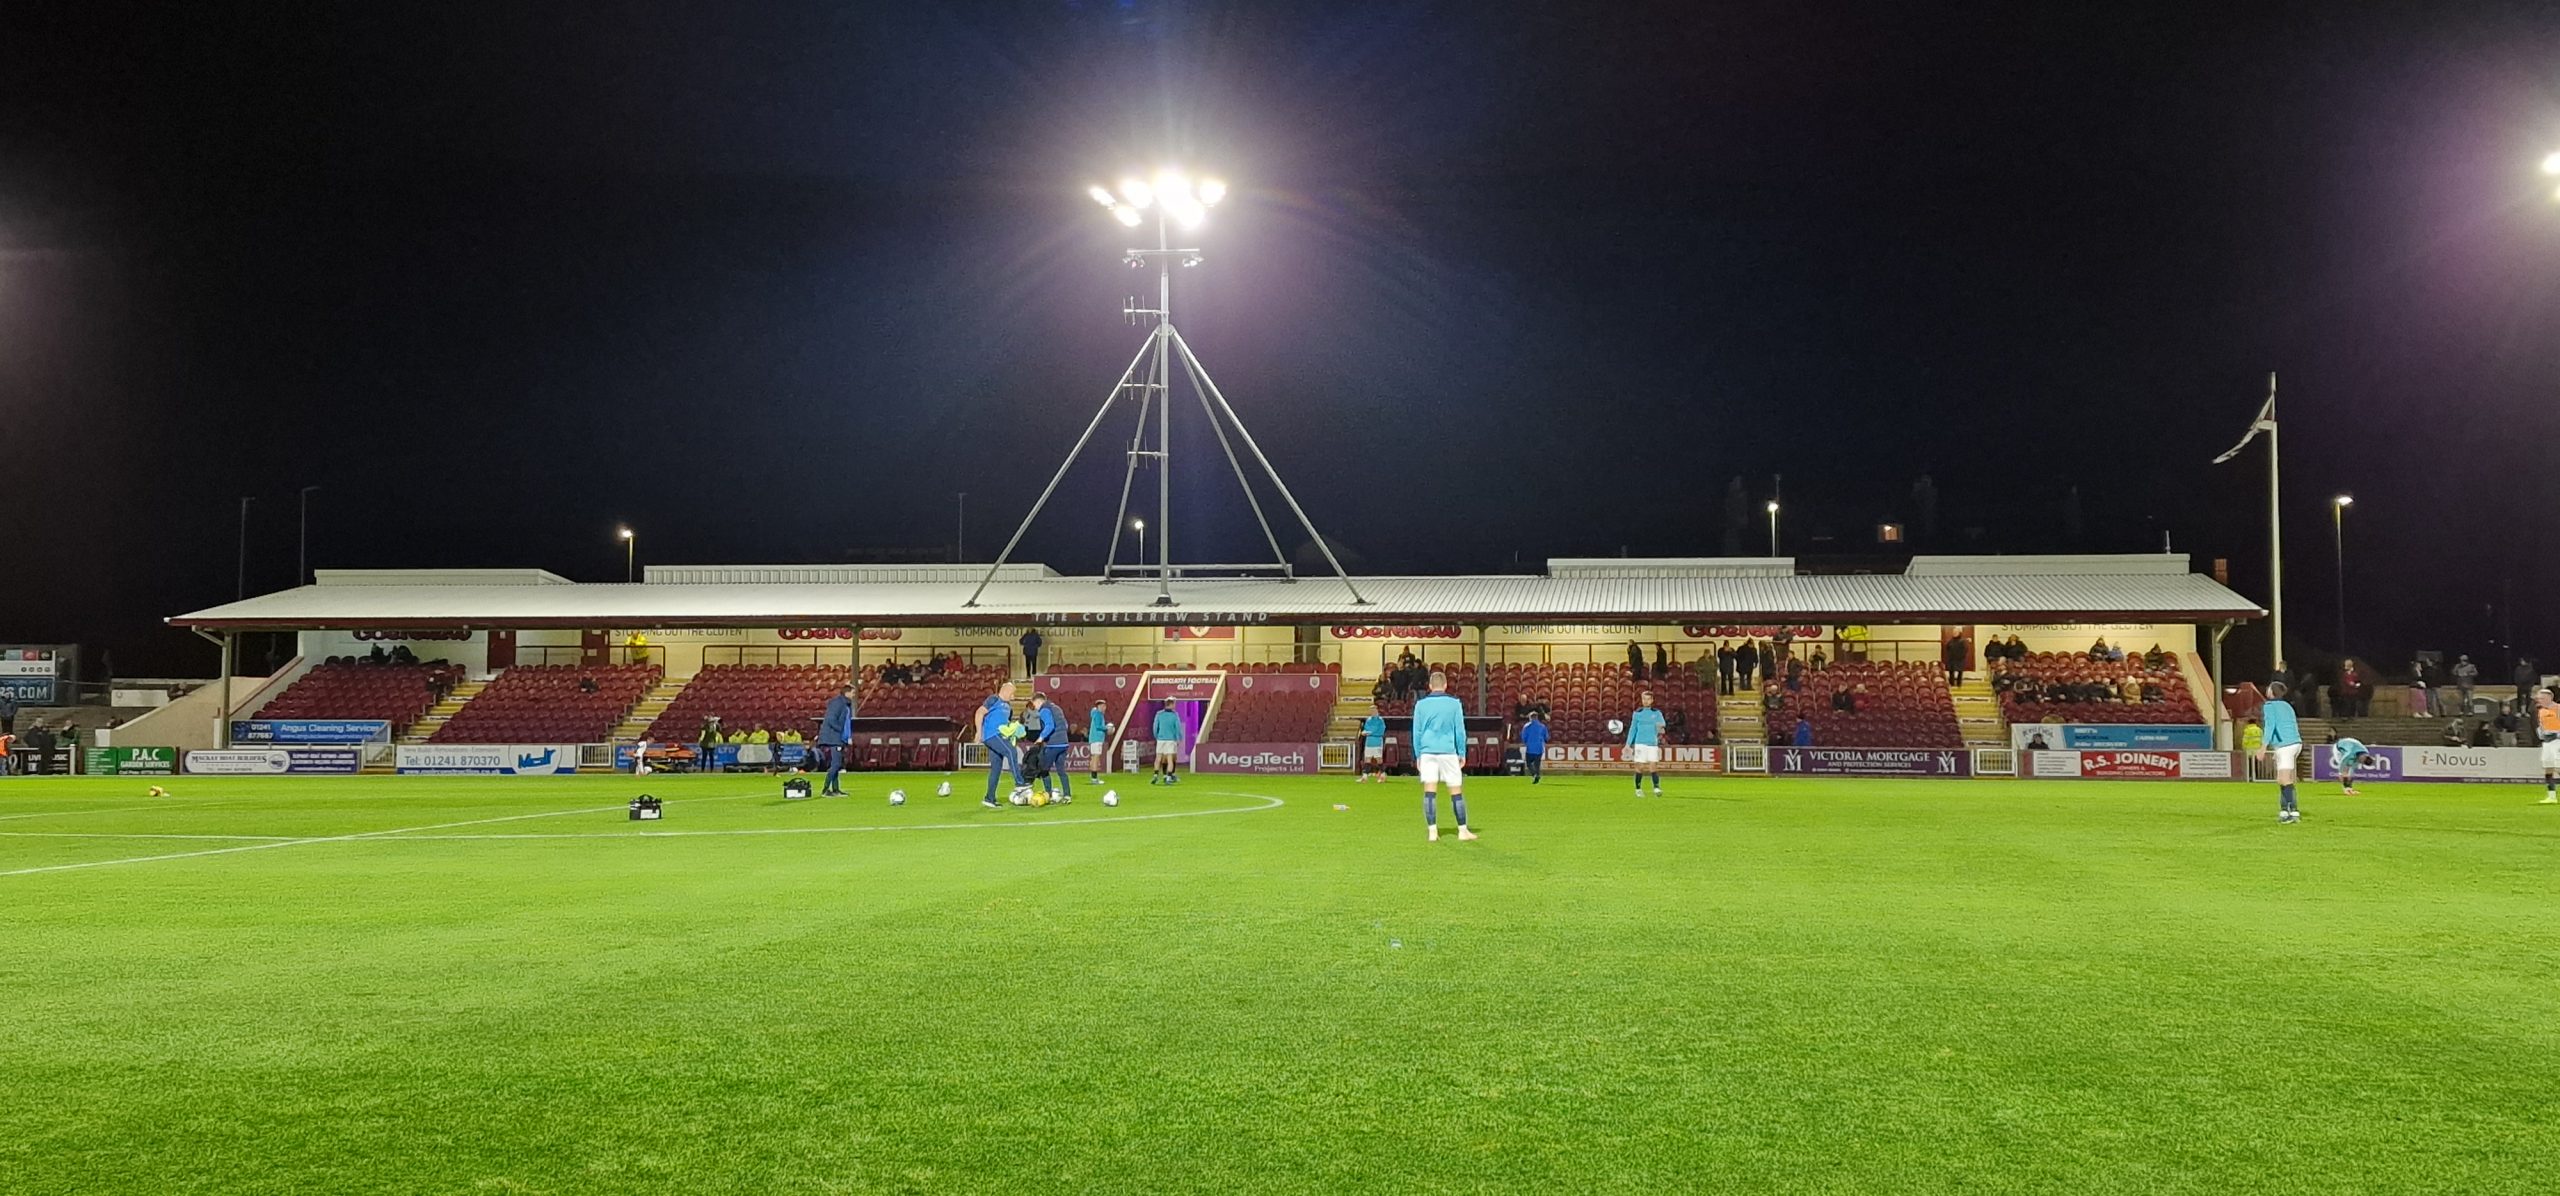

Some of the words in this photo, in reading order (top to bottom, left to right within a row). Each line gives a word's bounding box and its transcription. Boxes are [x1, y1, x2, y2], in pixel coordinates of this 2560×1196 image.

[1035, 612, 1067, 621] THE
[1082, 612, 1188, 622] COELBREW
[1203, 612, 1267, 621] STAND
[1502, 625, 1554, 634] STOMPING
[1601, 625, 1642, 634] GLUTEN
[280, 723, 306, 733] Angus
[308, 723, 345, 734] Cleaning
[345, 723, 381, 732] Services
[423, 755, 457, 766] 01241
[460, 755, 501, 766] 870370
[1208, 751, 1304, 767] MegaTech
[1808, 750, 1863, 761] VICTORIA
[1866, 751, 1931, 762] MORTGAGE
[2083, 755, 2111, 771] R.S.
[2113, 752, 2179, 770] JOINERY
[2422, 750, 2488, 766] i-Novus
